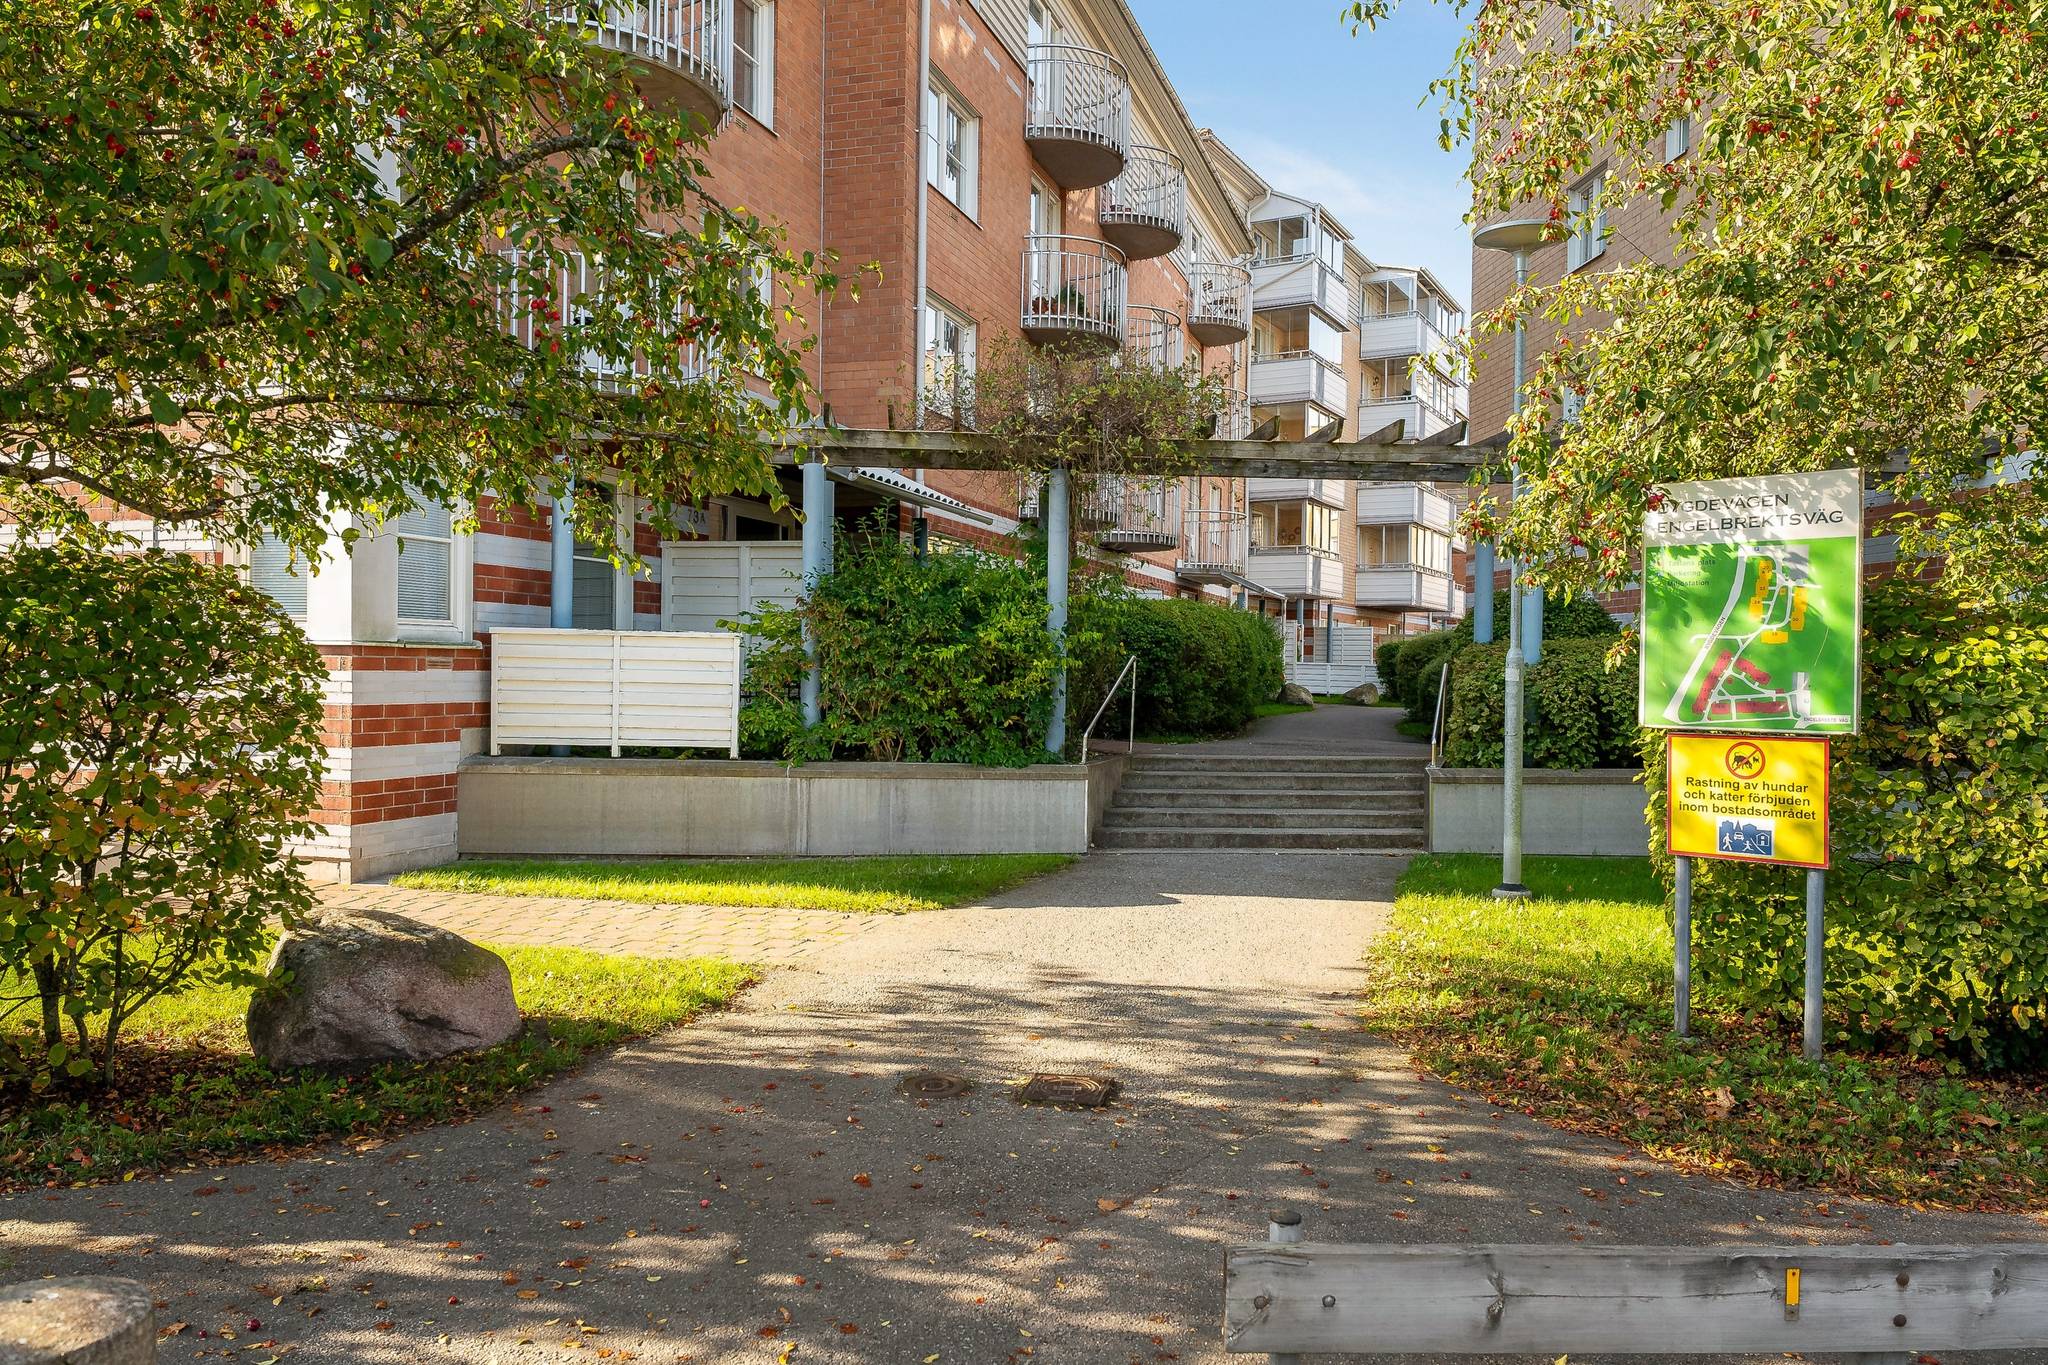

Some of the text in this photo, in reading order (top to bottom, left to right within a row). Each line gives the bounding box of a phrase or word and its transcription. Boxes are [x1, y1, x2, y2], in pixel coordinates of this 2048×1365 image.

[1658, 509, 1844, 534] ENGELBREKTSVÄG
[1686, 776, 1809, 793] Rastning av hundar
[1683, 790, 1810, 807] och katter förbjuden
[1679, 801, 1816, 820] inom bostadsområdet
